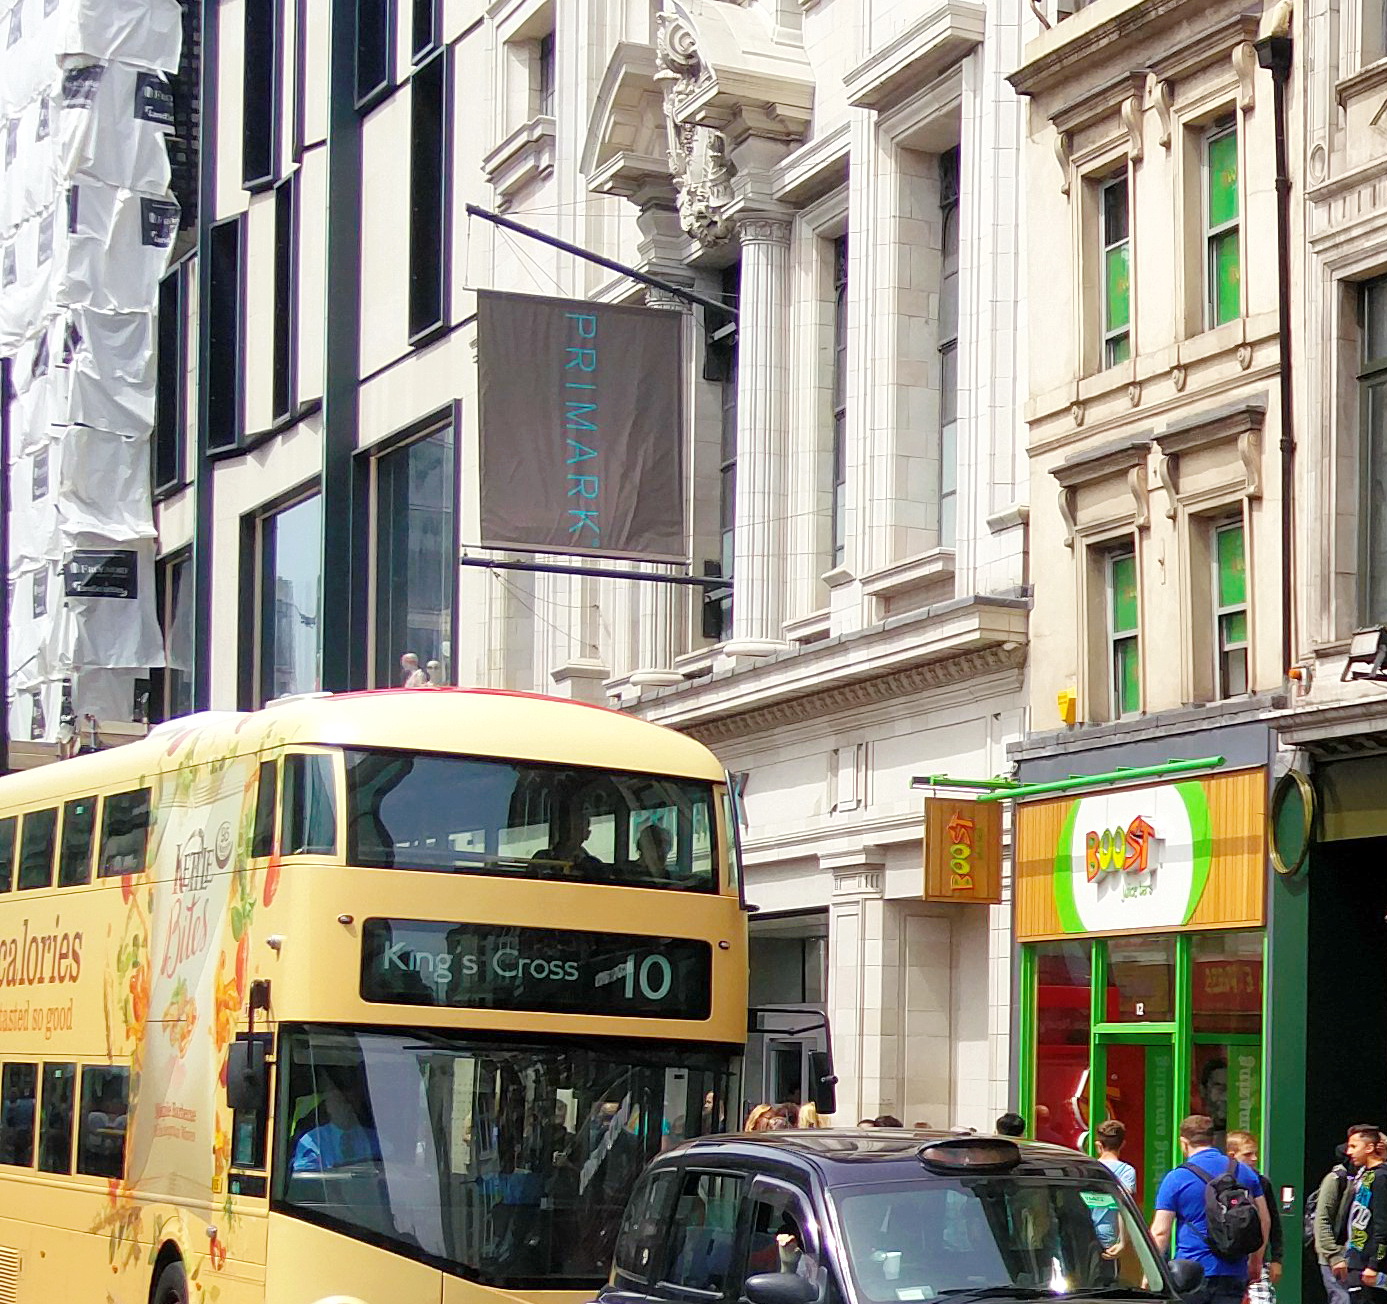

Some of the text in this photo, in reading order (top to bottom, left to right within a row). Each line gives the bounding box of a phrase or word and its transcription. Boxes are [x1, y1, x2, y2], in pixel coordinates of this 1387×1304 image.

[565, 312, 600, 535] PRIMARK
[946, 811, 974, 890] BOOST
[1085, 814, 1156, 884] BOOST
[160, 895, 209, 979] Bites
[383, 940, 672, 1000] King's Cross 10
[32, 1008, 44, 1032] so
[45, 998, 73, 1040] good
[1236, 1056, 1256, 1130] mazing
